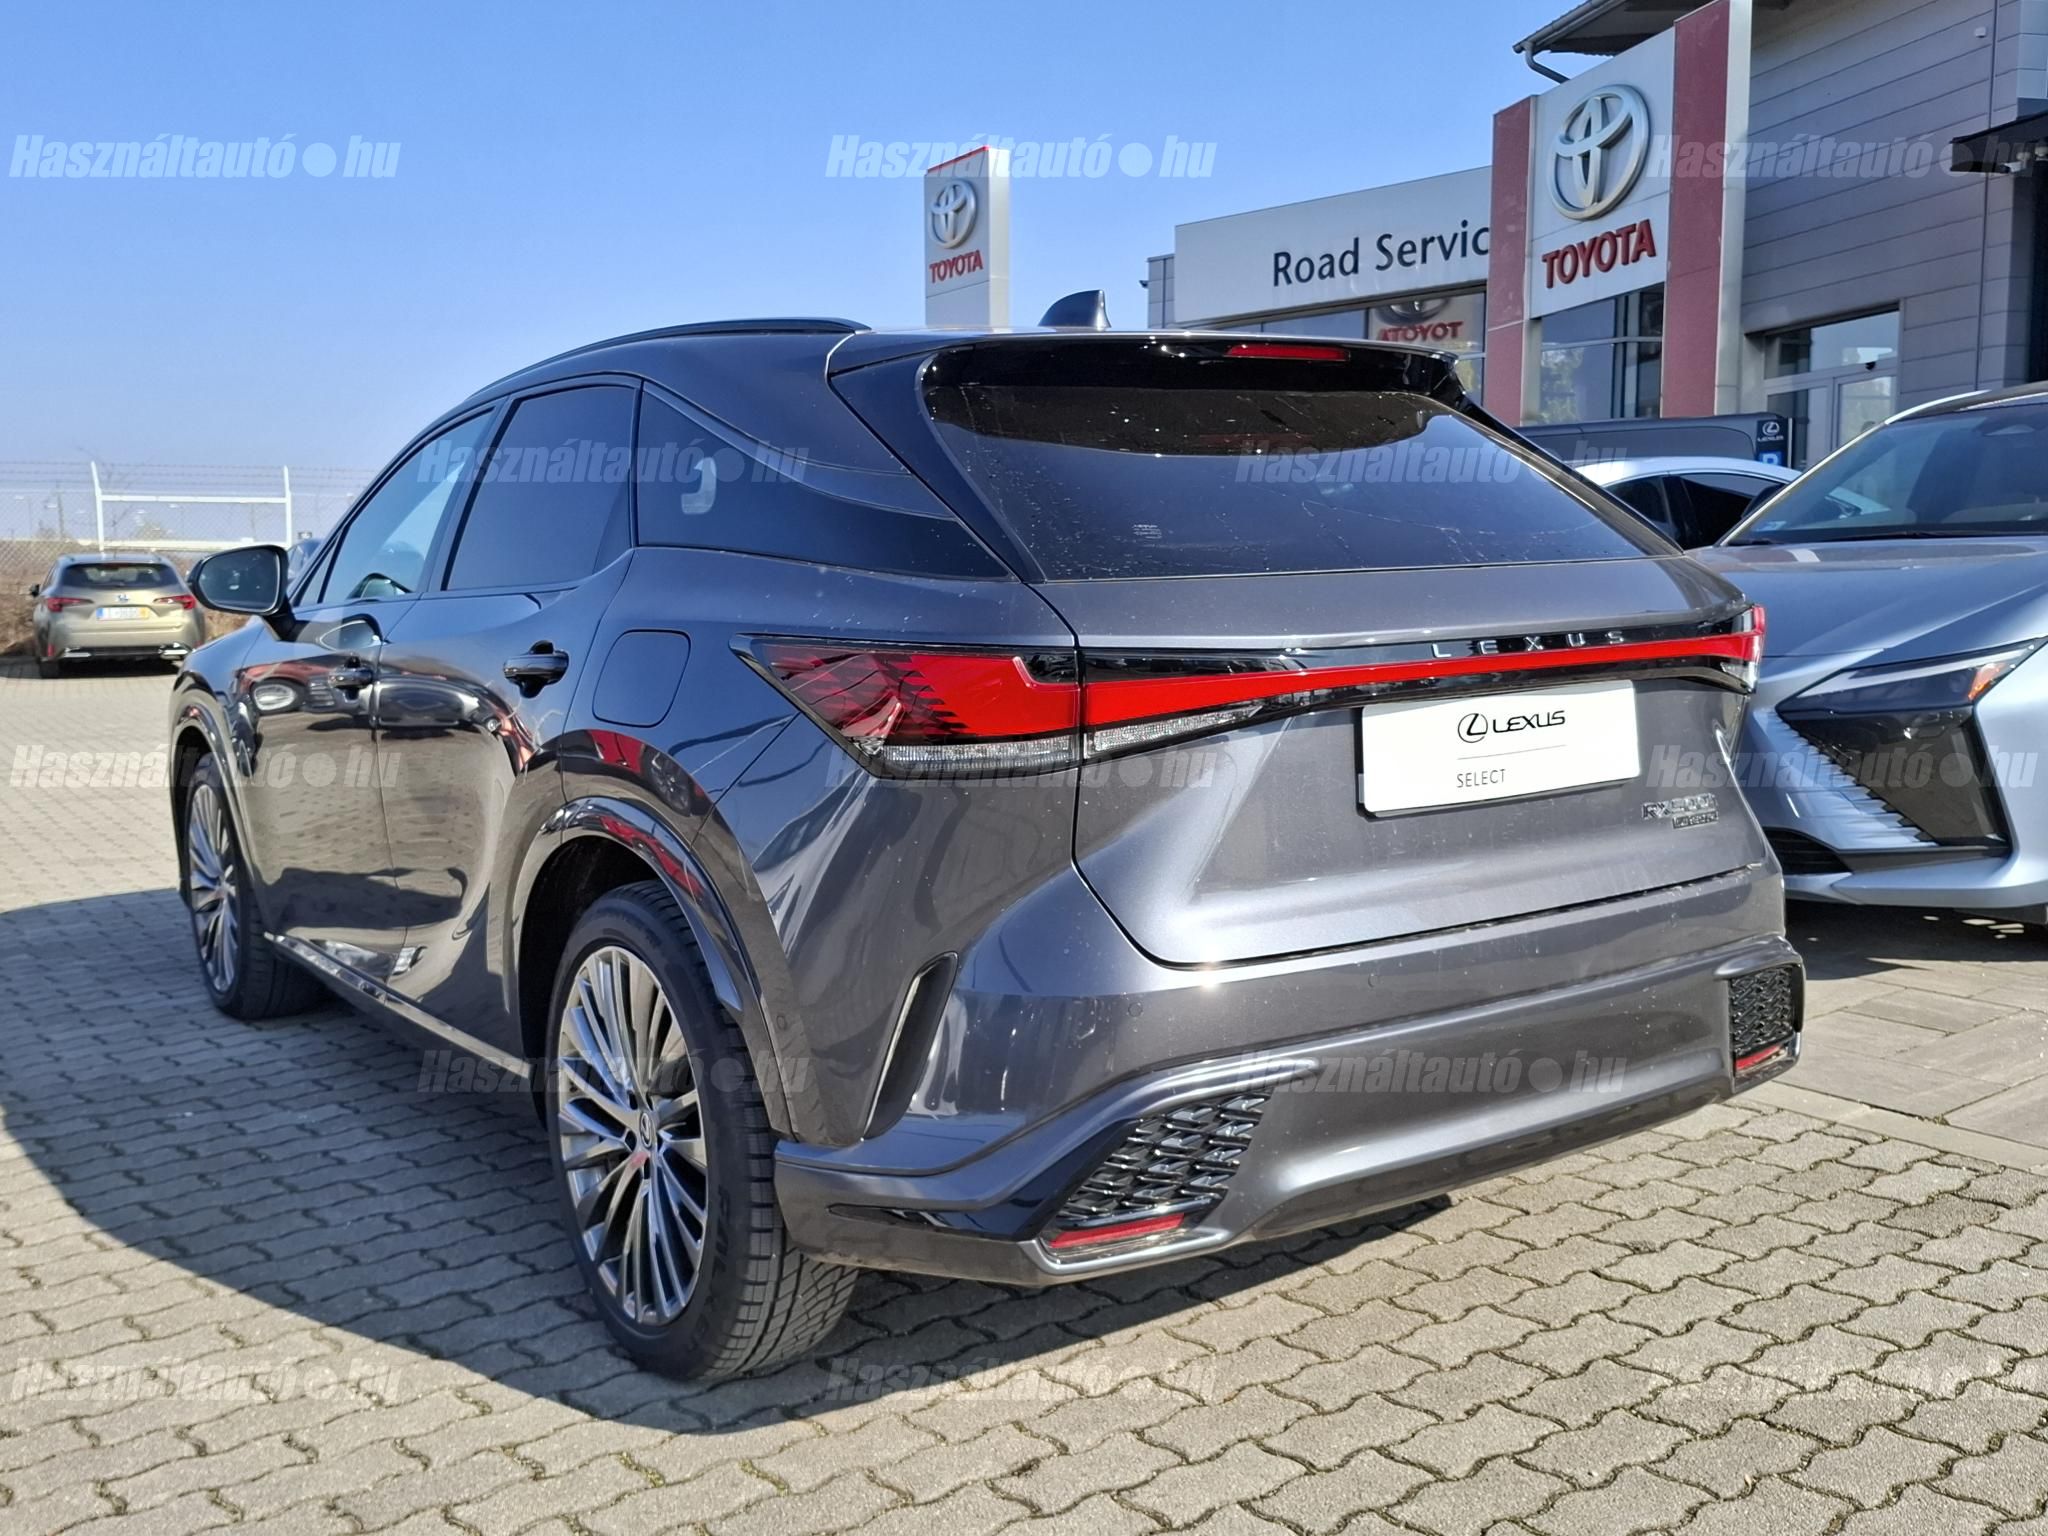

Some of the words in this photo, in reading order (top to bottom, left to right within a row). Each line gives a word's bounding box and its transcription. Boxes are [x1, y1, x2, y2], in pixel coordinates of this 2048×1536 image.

[929, 249, 984, 283] TOYOTA
[1273, 237, 1359, 287] Road
[1541, 218, 1656, 289] TOYOTA
[1431, 631, 1624, 658] LEXUS
[1493, 710, 1566, 734] LEXUS
[1457, 768, 1506, 788] SELECT
